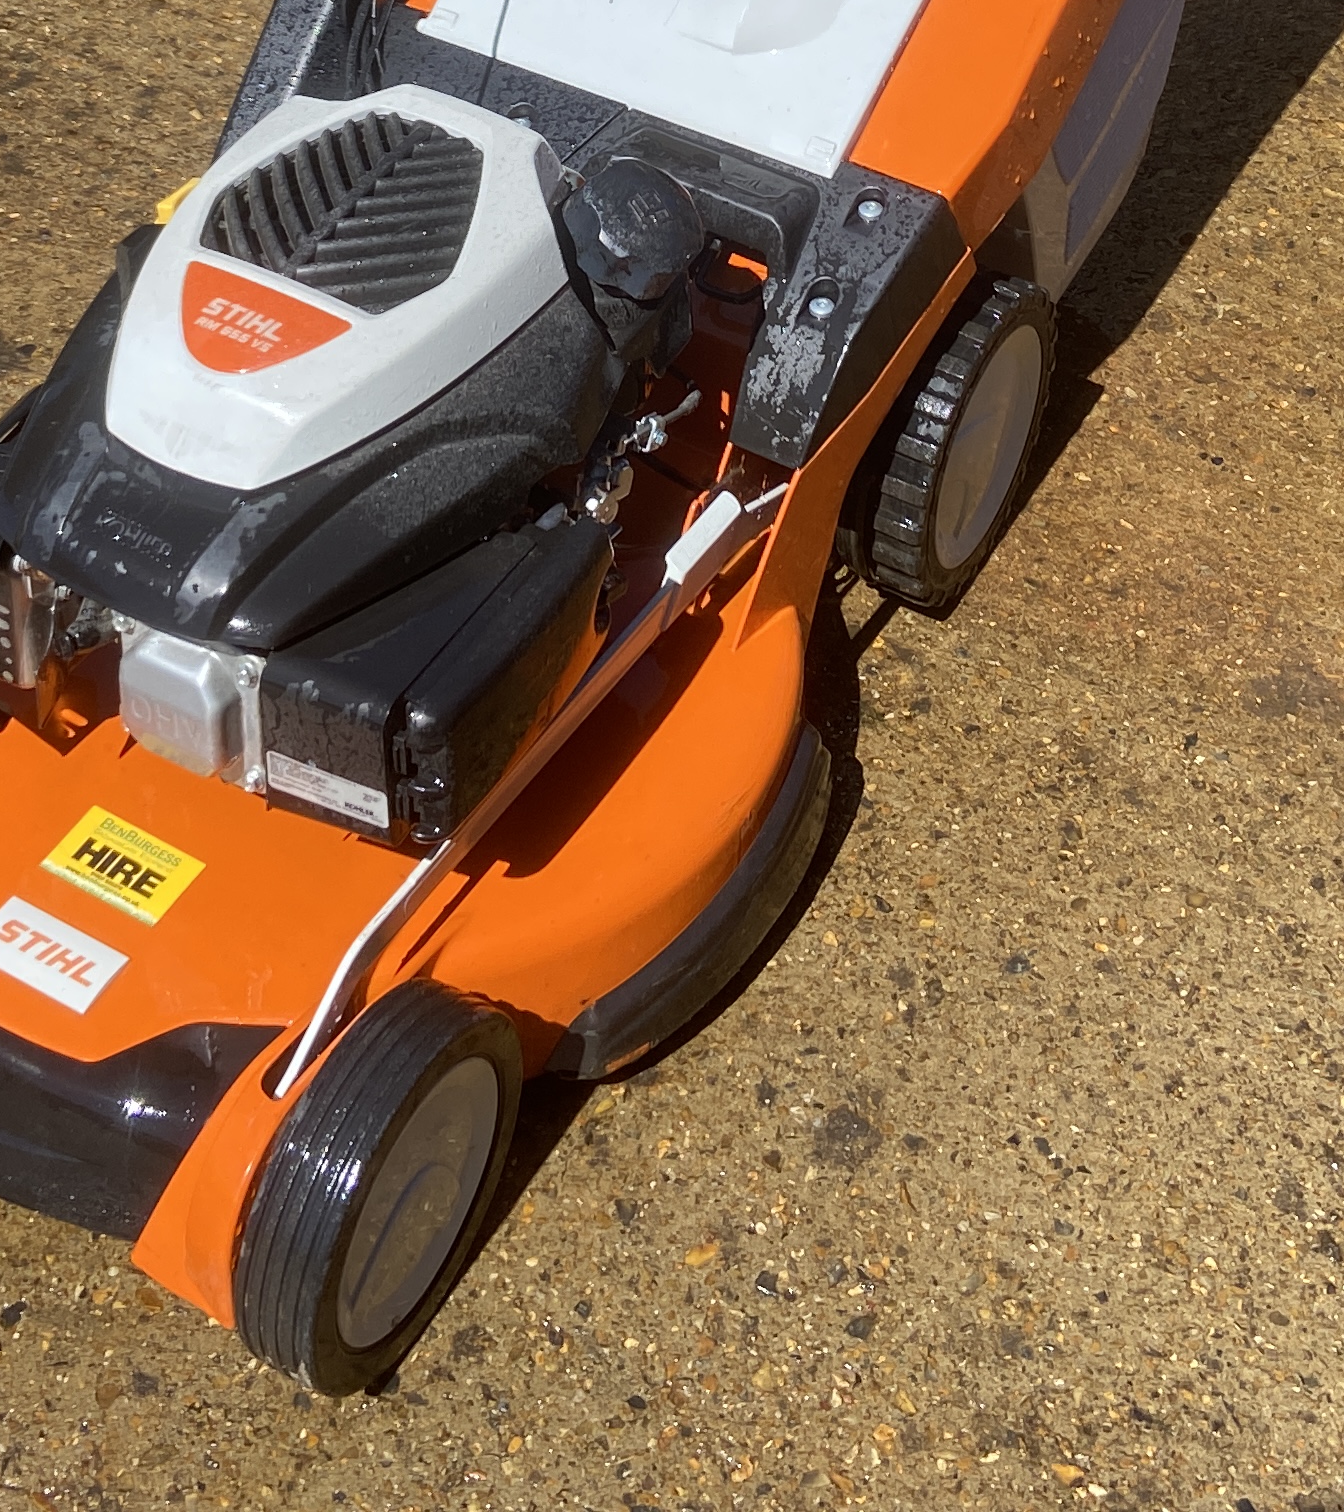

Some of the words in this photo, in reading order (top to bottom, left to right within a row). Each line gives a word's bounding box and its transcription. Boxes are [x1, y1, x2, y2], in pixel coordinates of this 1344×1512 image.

[194, 316, 223, 332] RM
[200, 297, 283, 341] STIHL
[71, 837, 167, 899] HIRE
